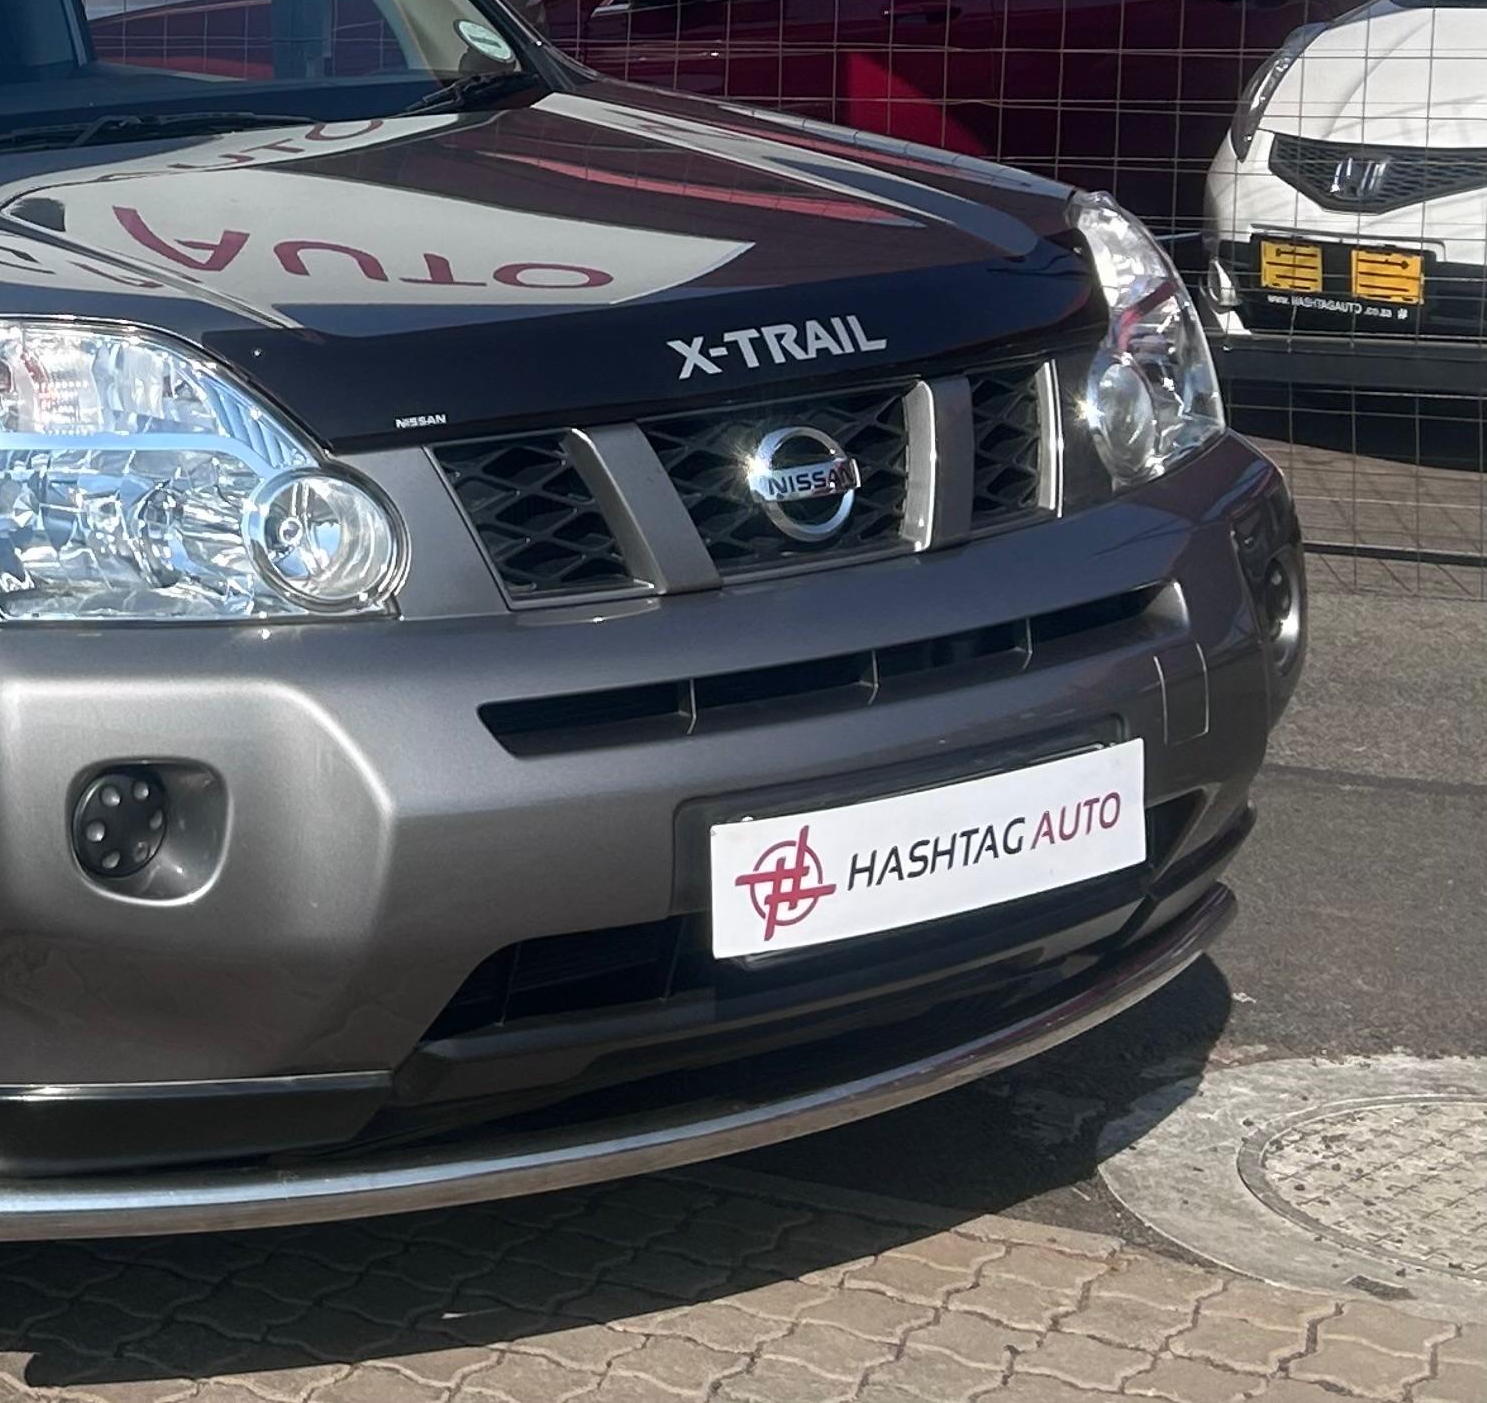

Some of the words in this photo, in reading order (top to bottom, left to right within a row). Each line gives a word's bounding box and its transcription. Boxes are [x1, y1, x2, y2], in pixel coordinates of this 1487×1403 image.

[666, 314, 888, 380] X-TRAIL
[395, 413, 447, 429] NISSAN
[768, 467, 855, 496] NISSAN
[847, 817, 1026, 891] HASHTAG
[1030, 791, 1122, 851] AUTO
